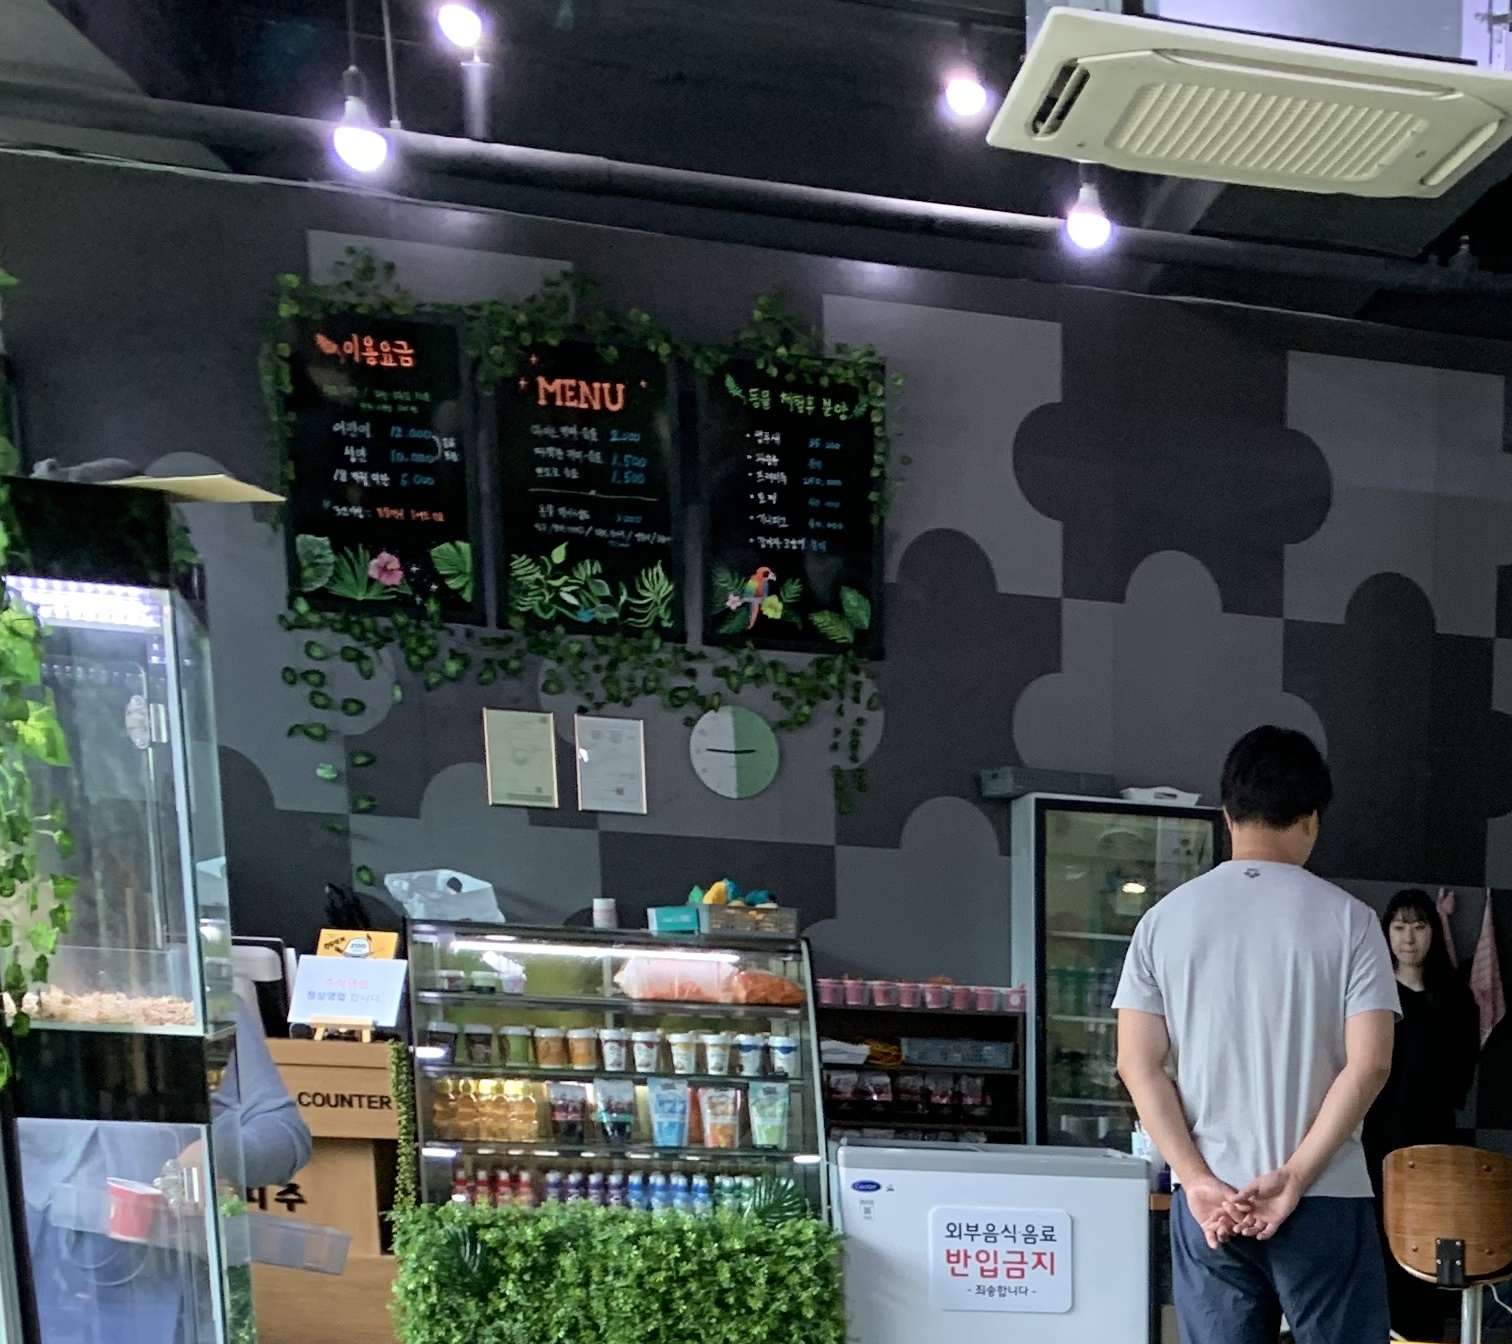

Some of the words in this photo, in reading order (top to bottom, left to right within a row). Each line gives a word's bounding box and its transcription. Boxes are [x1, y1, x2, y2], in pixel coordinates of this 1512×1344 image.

[343, 333, 415, 367] 이용요금
[536, 375, 625, 411] MENU
[297, 1091, 392, 1110] COUNTER
[945, 1249, 1056, 1279] 반입금지
[975, 1284, 1029, 1298] 죄송합니다
